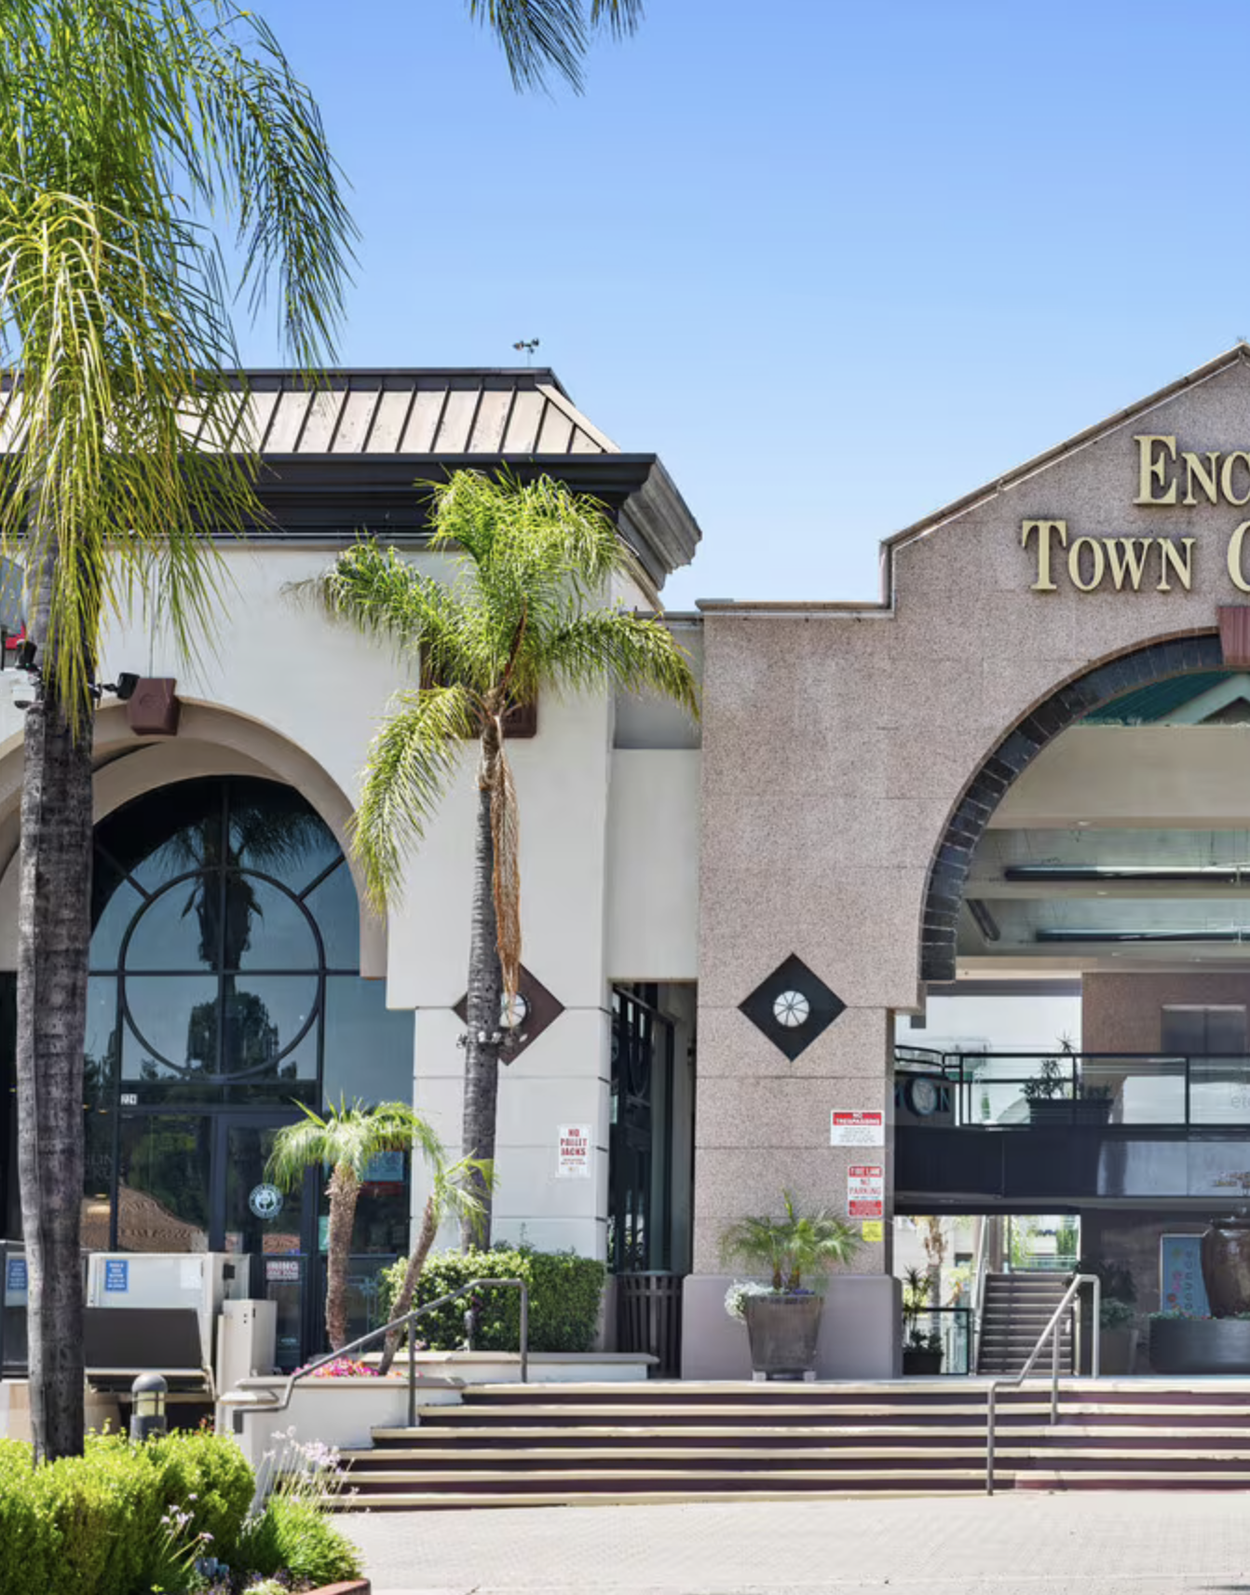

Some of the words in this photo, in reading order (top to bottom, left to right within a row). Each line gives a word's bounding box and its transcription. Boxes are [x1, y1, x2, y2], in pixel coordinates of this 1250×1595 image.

[1021, 519, 1197, 592] TOWN
[568, 1129, 580, 1137] NO
[561, 1147, 586, 1156] JACKS
[849, 1187, 881, 1195] PARKING
